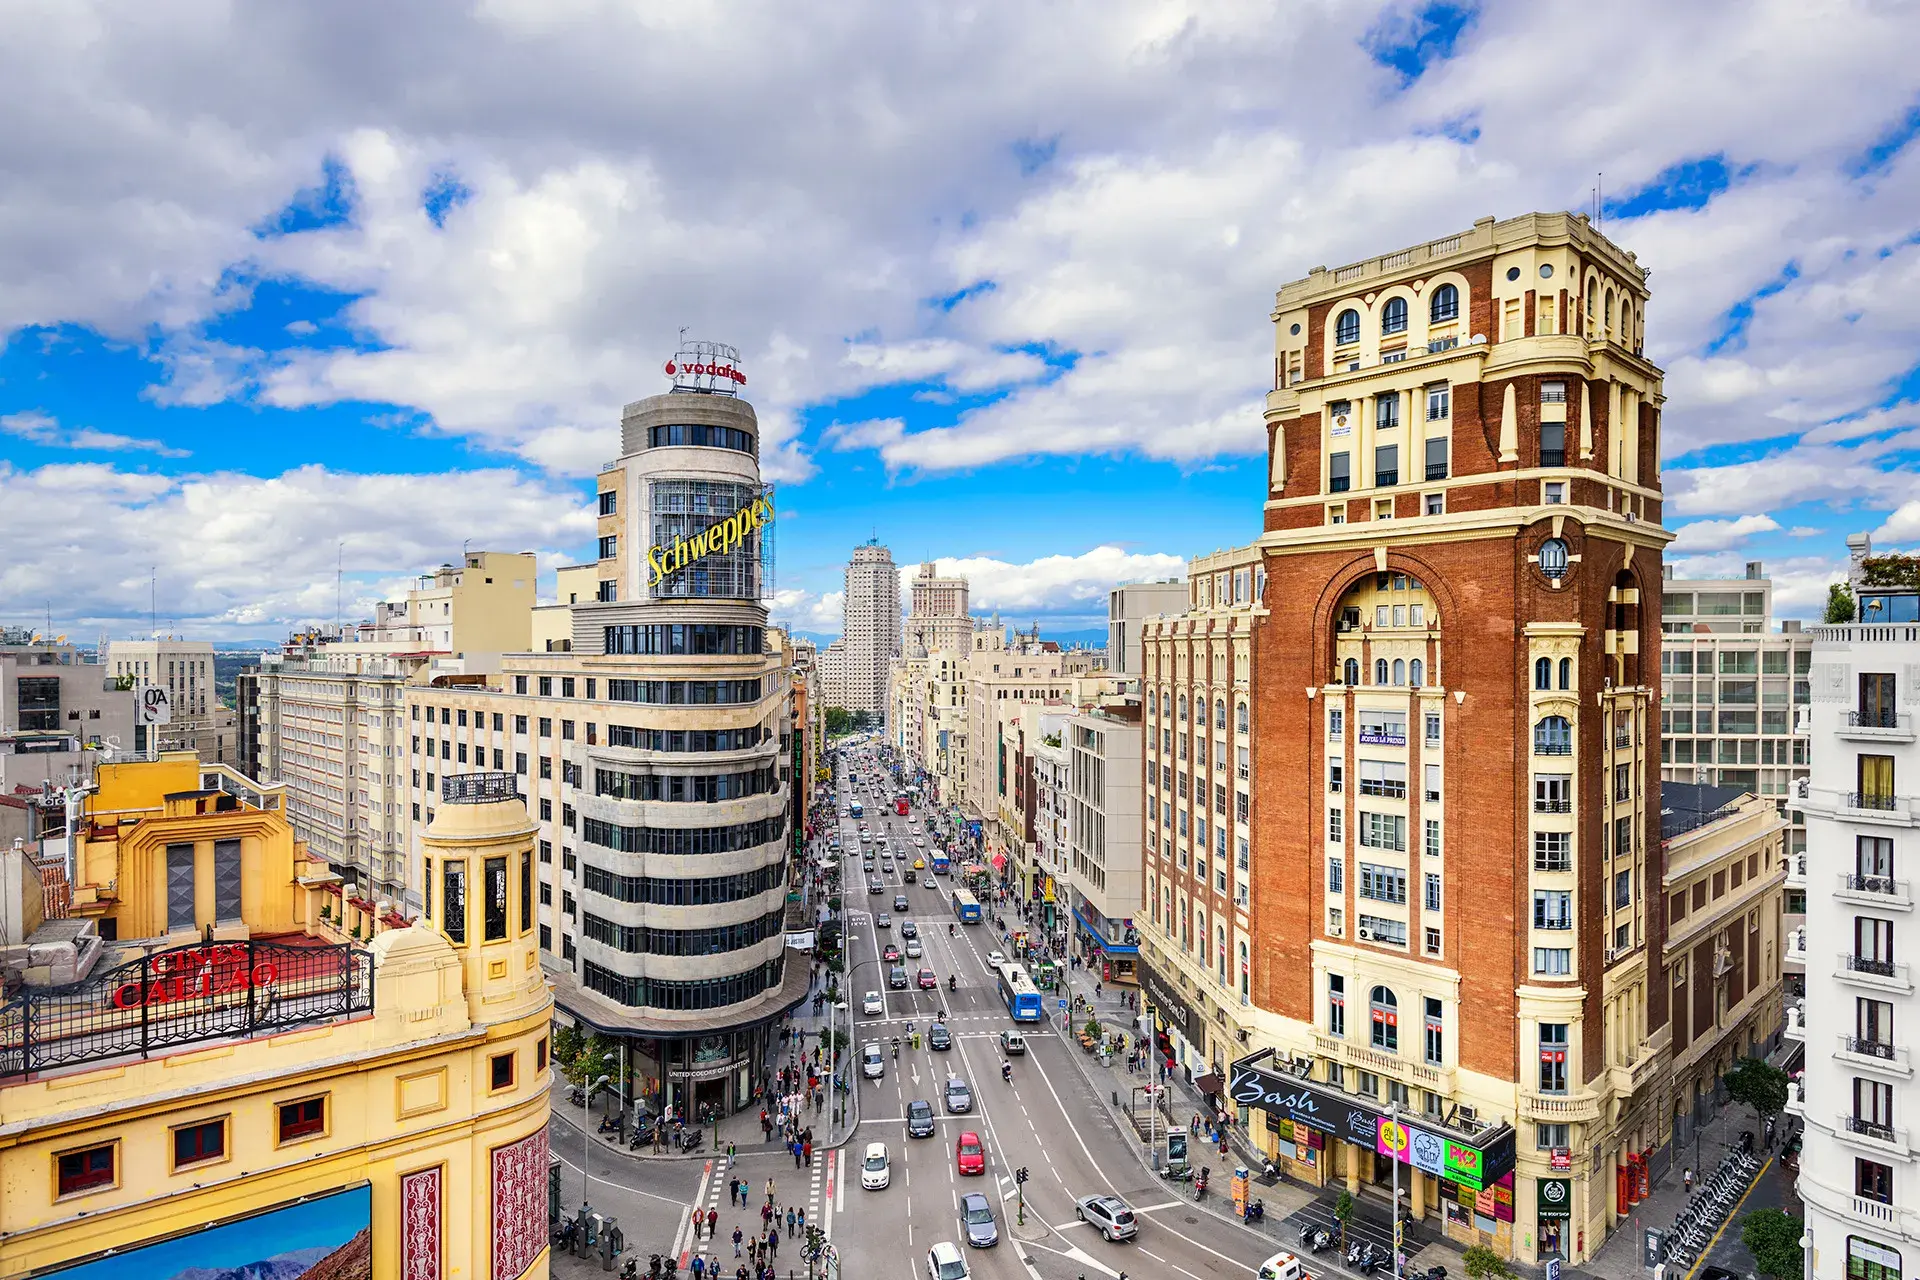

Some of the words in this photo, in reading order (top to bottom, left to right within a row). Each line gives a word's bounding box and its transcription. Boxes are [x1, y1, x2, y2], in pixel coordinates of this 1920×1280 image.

[647, 492, 775, 587] Schweppes
[151, 942, 246, 975] CINES
[113, 963, 278, 1009] CALLAO
[691, 1068, 715, 1077] COLORS
[725, 1058, 750, 1072] BENETTON
[1231, 1067, 1319, 1112] Bash
[1416, 1161, 1438, 1172] viernes
[1450, 1144, 1476, 1168] PK2
